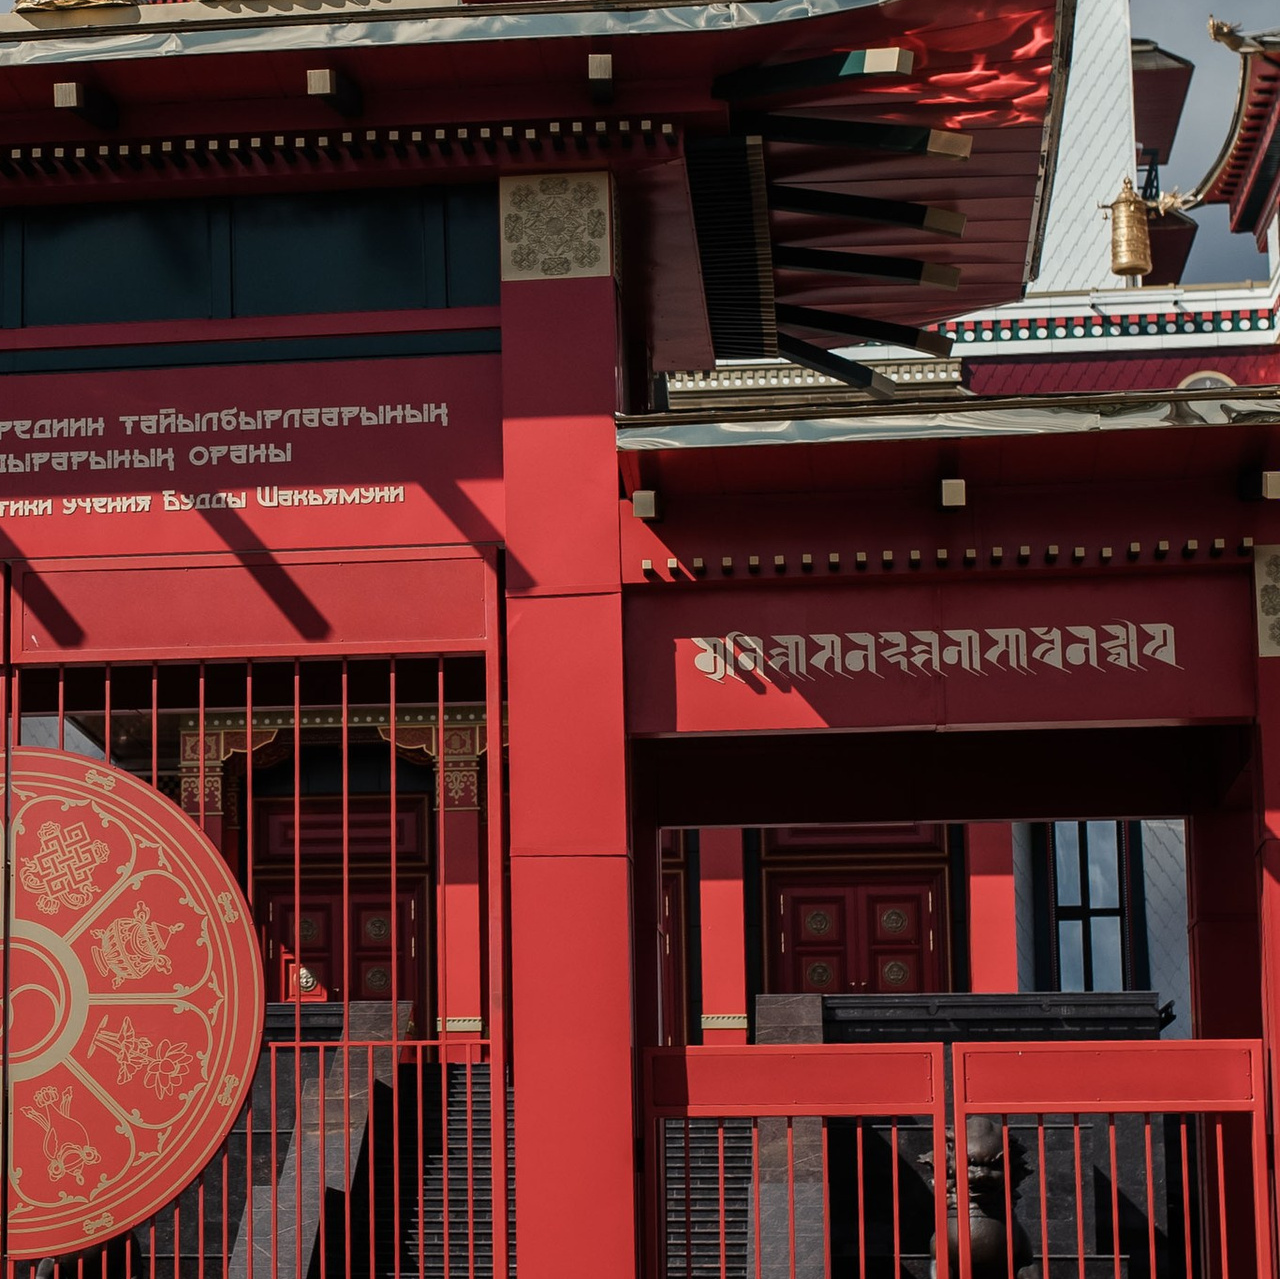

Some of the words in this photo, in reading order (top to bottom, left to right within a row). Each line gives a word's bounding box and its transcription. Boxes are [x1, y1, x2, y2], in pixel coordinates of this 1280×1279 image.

[188, 442, 292, 466] ораны
[62, 495, 152, 515] учения
[161, 489, 247, 511] Будды
[256, 485, 405, 507] Шакьямуни
